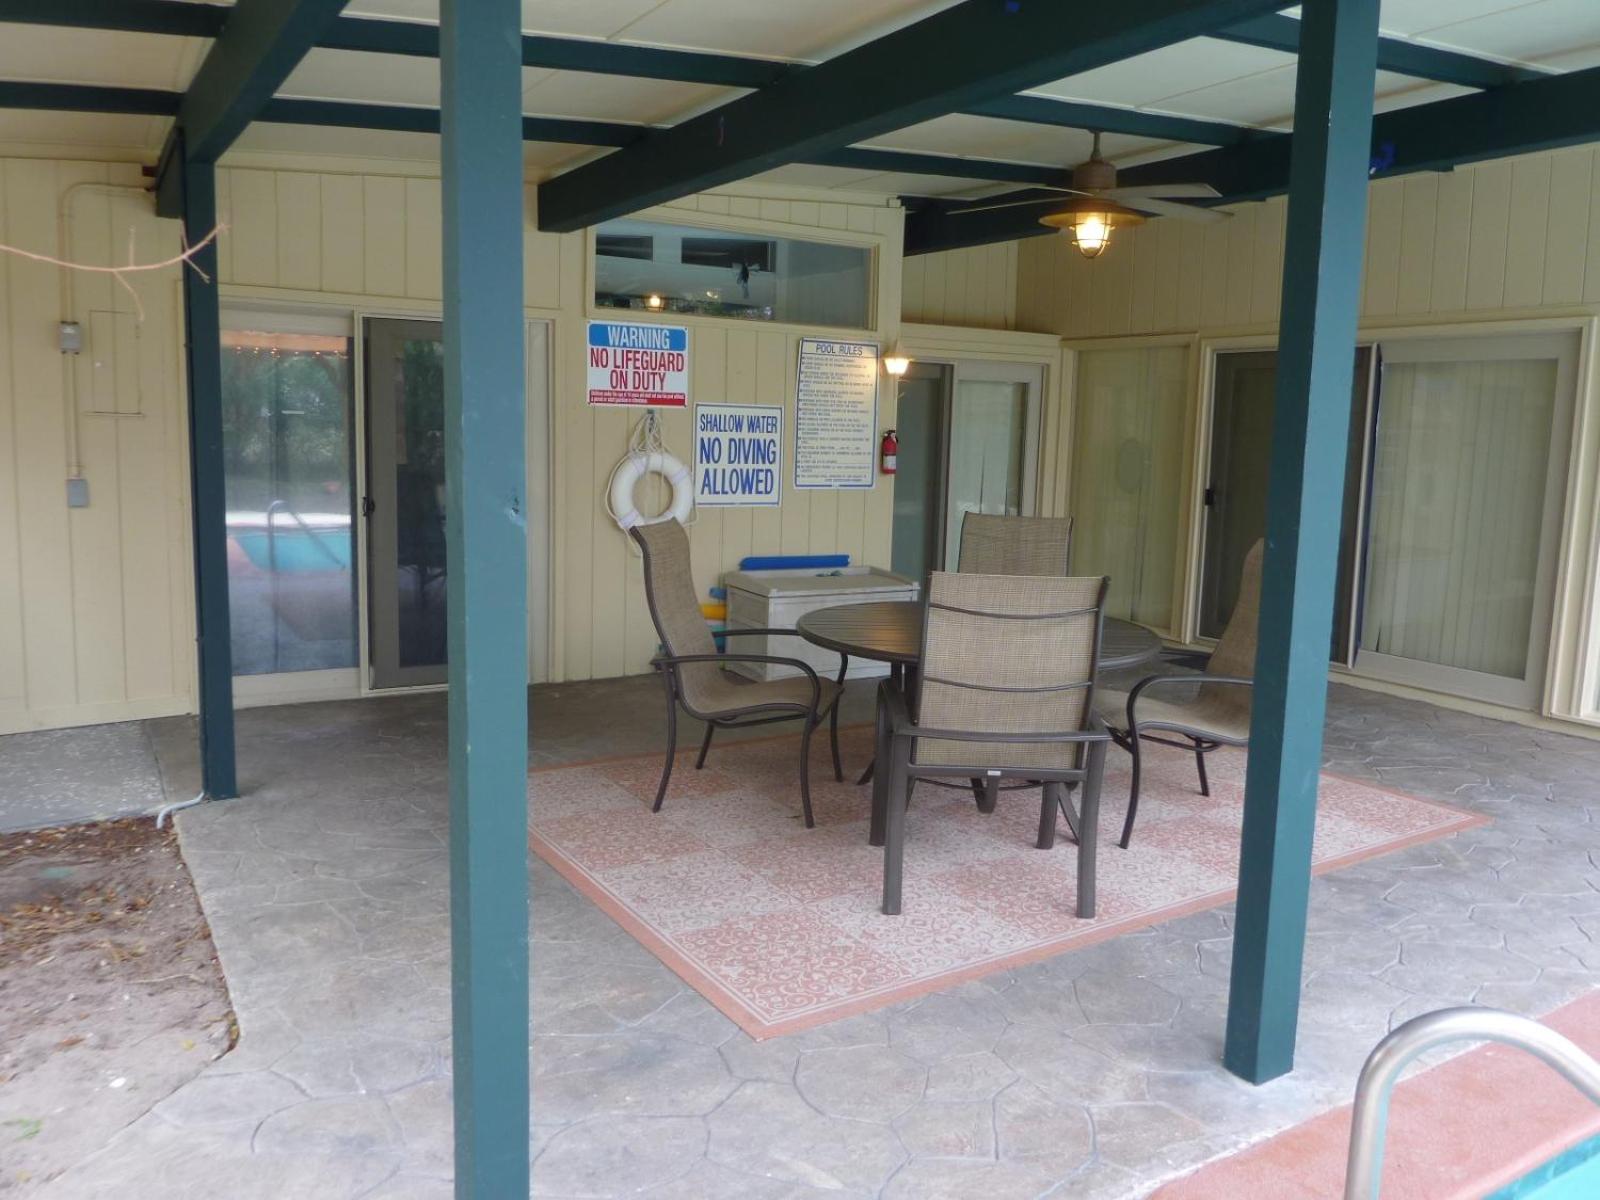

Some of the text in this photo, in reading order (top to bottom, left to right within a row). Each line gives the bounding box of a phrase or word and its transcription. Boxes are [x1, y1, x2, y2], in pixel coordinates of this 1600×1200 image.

[607, 325, 670, 349] WARNING
[590, 348, 684, 372] NO LIFEGUARD
[815, 343, 863, 356] POOL RULES
[609, 370, 666, 391] ON DUTY
[700, 414, 778, 434] SHALLOW WATER
[699, 436, 777, 465] NO DIVING
[700, 468, 774, 495] ALLOWED
